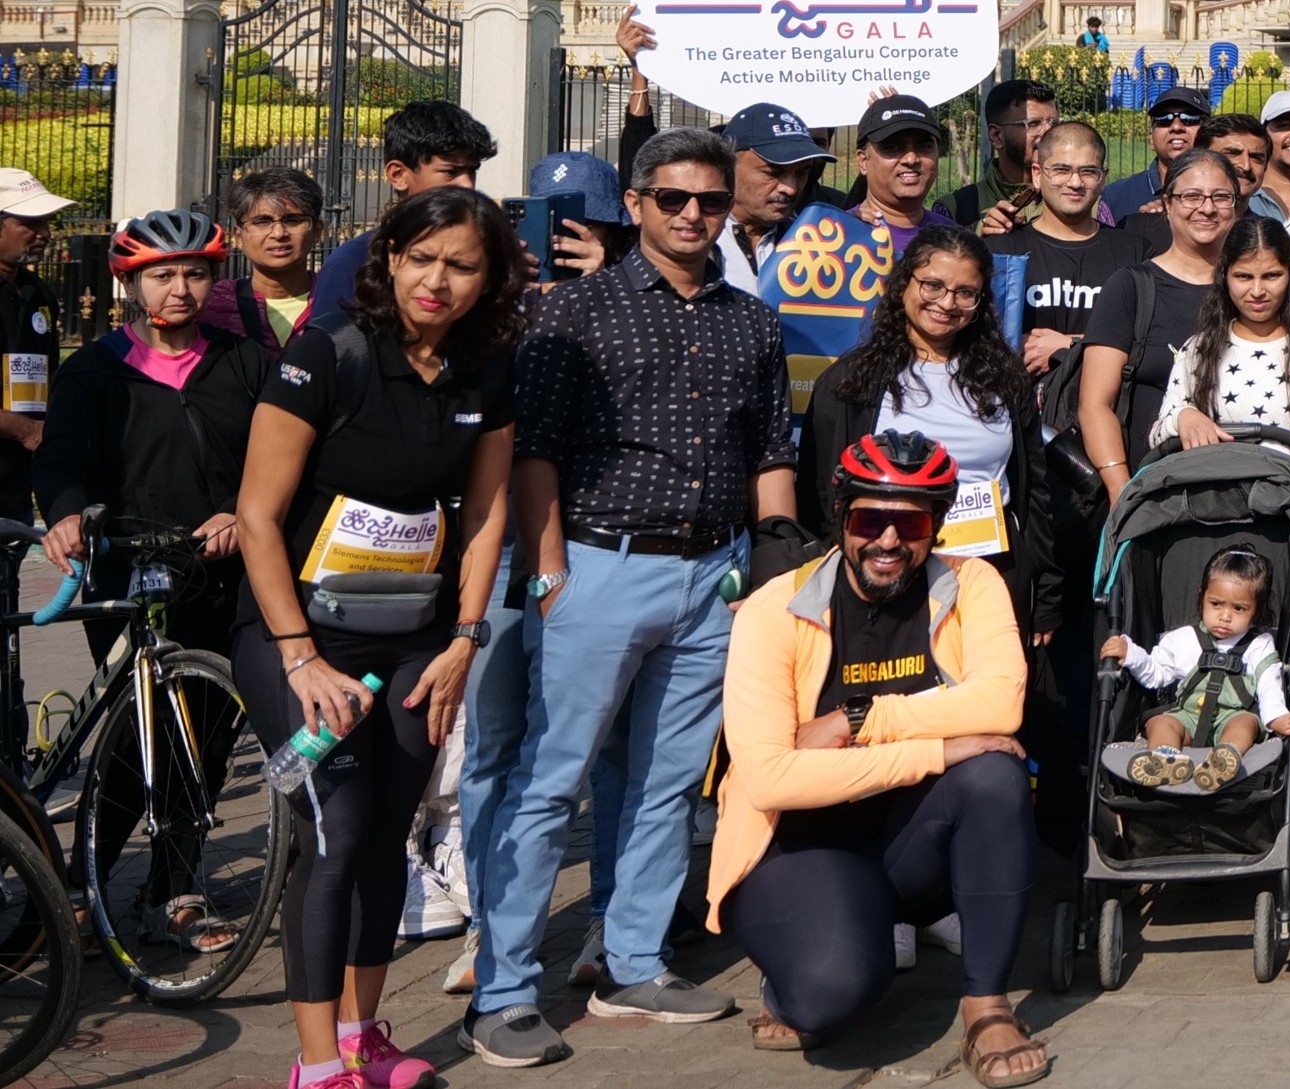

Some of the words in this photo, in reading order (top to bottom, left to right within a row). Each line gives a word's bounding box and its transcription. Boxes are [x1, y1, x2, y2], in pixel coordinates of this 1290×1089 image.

[837, 22, 933, 39] GALA
[685, 48, 717, 61] The
[722, 47, 786, 61] Greater
[792, 45, 875, 63] Bengaluru
[879, 45, 959, 63] Corporate
[720, 71, 774, 84] Active
[779, 69, 847, 85] Mobility
[851, 68, 931, 85] Challenge
[1026, 277, 1102, 309] altm
[790, 378, 814, 392] reat
[454, 412, 484, 424] SIEME
[389, 516, 437, 543] Hejje
[331, 547, 370, 562] Siemens
[371, 554, 426, 566] Technologies
[348, 562, 366, 571] and
[842, 654, 925, 684] BENGALURU
[42, 660, 112, 778] SCOTT
